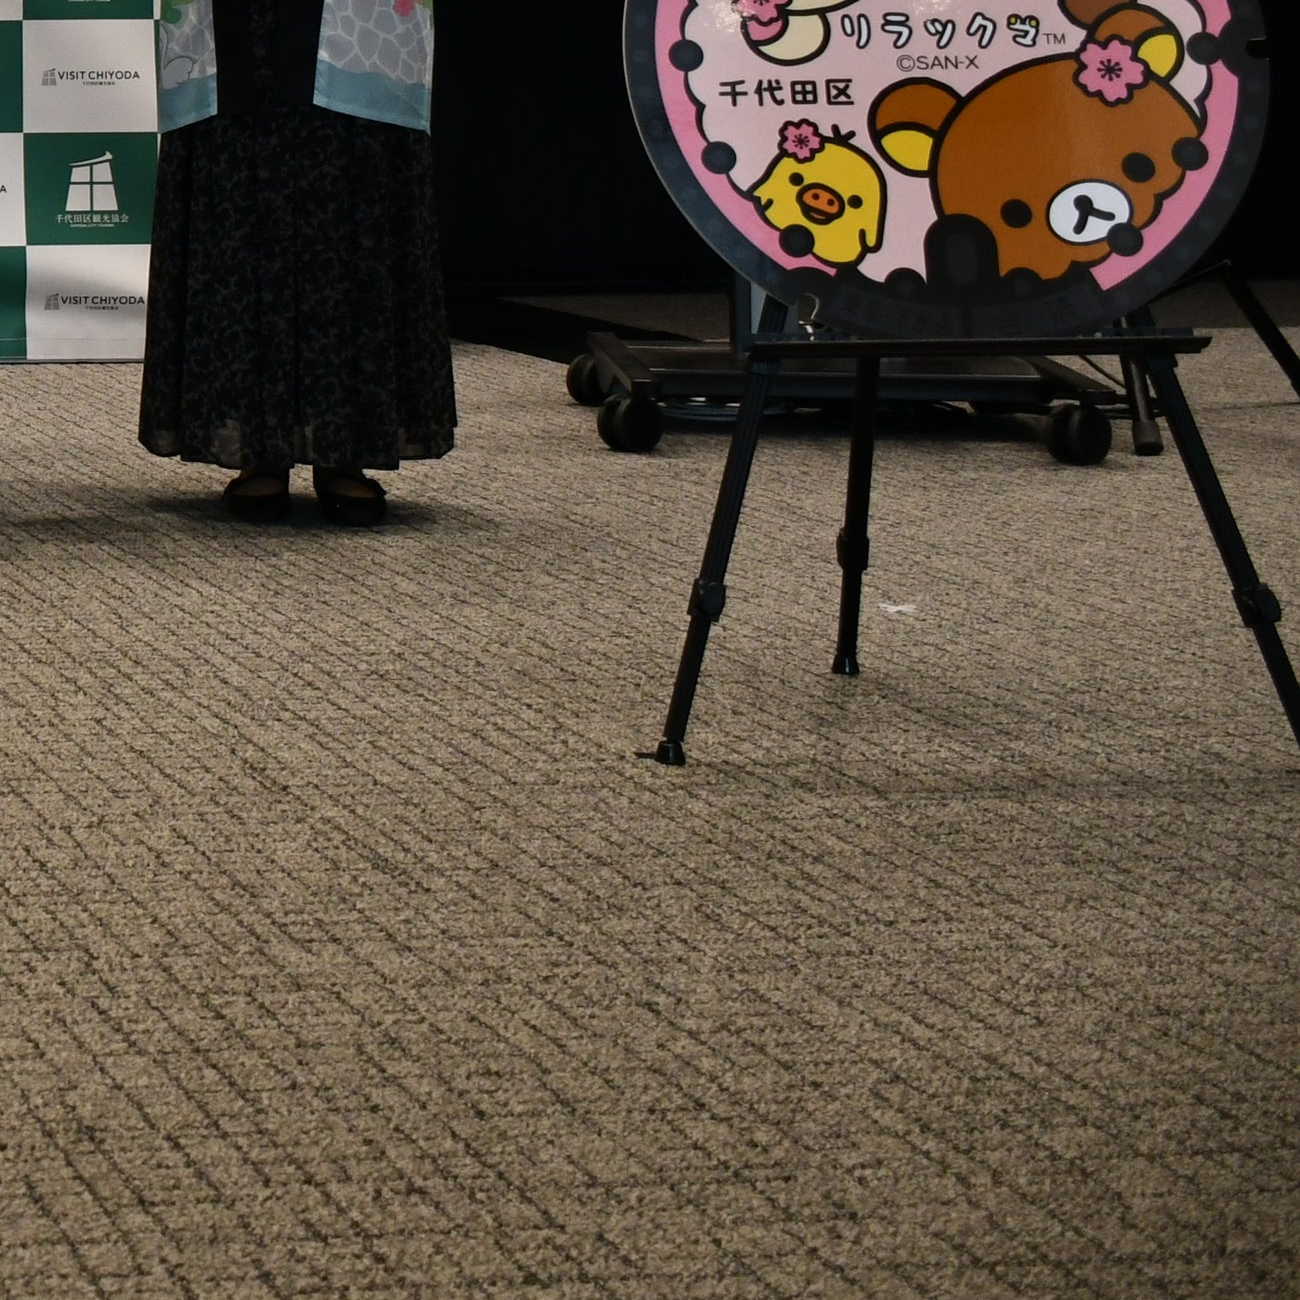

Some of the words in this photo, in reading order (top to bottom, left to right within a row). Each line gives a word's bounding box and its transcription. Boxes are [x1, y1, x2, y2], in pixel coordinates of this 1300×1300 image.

[840, 12, 1039, 49] リラックマ
[58, 70, 86, 80] VISIT
[88, 69, 140, 80] CHIYODA
[718, 77, 855, 107] 千代田区
[61, 295, 89, 306] VISIT
[91, 295, 145, 306] CHIYODA
